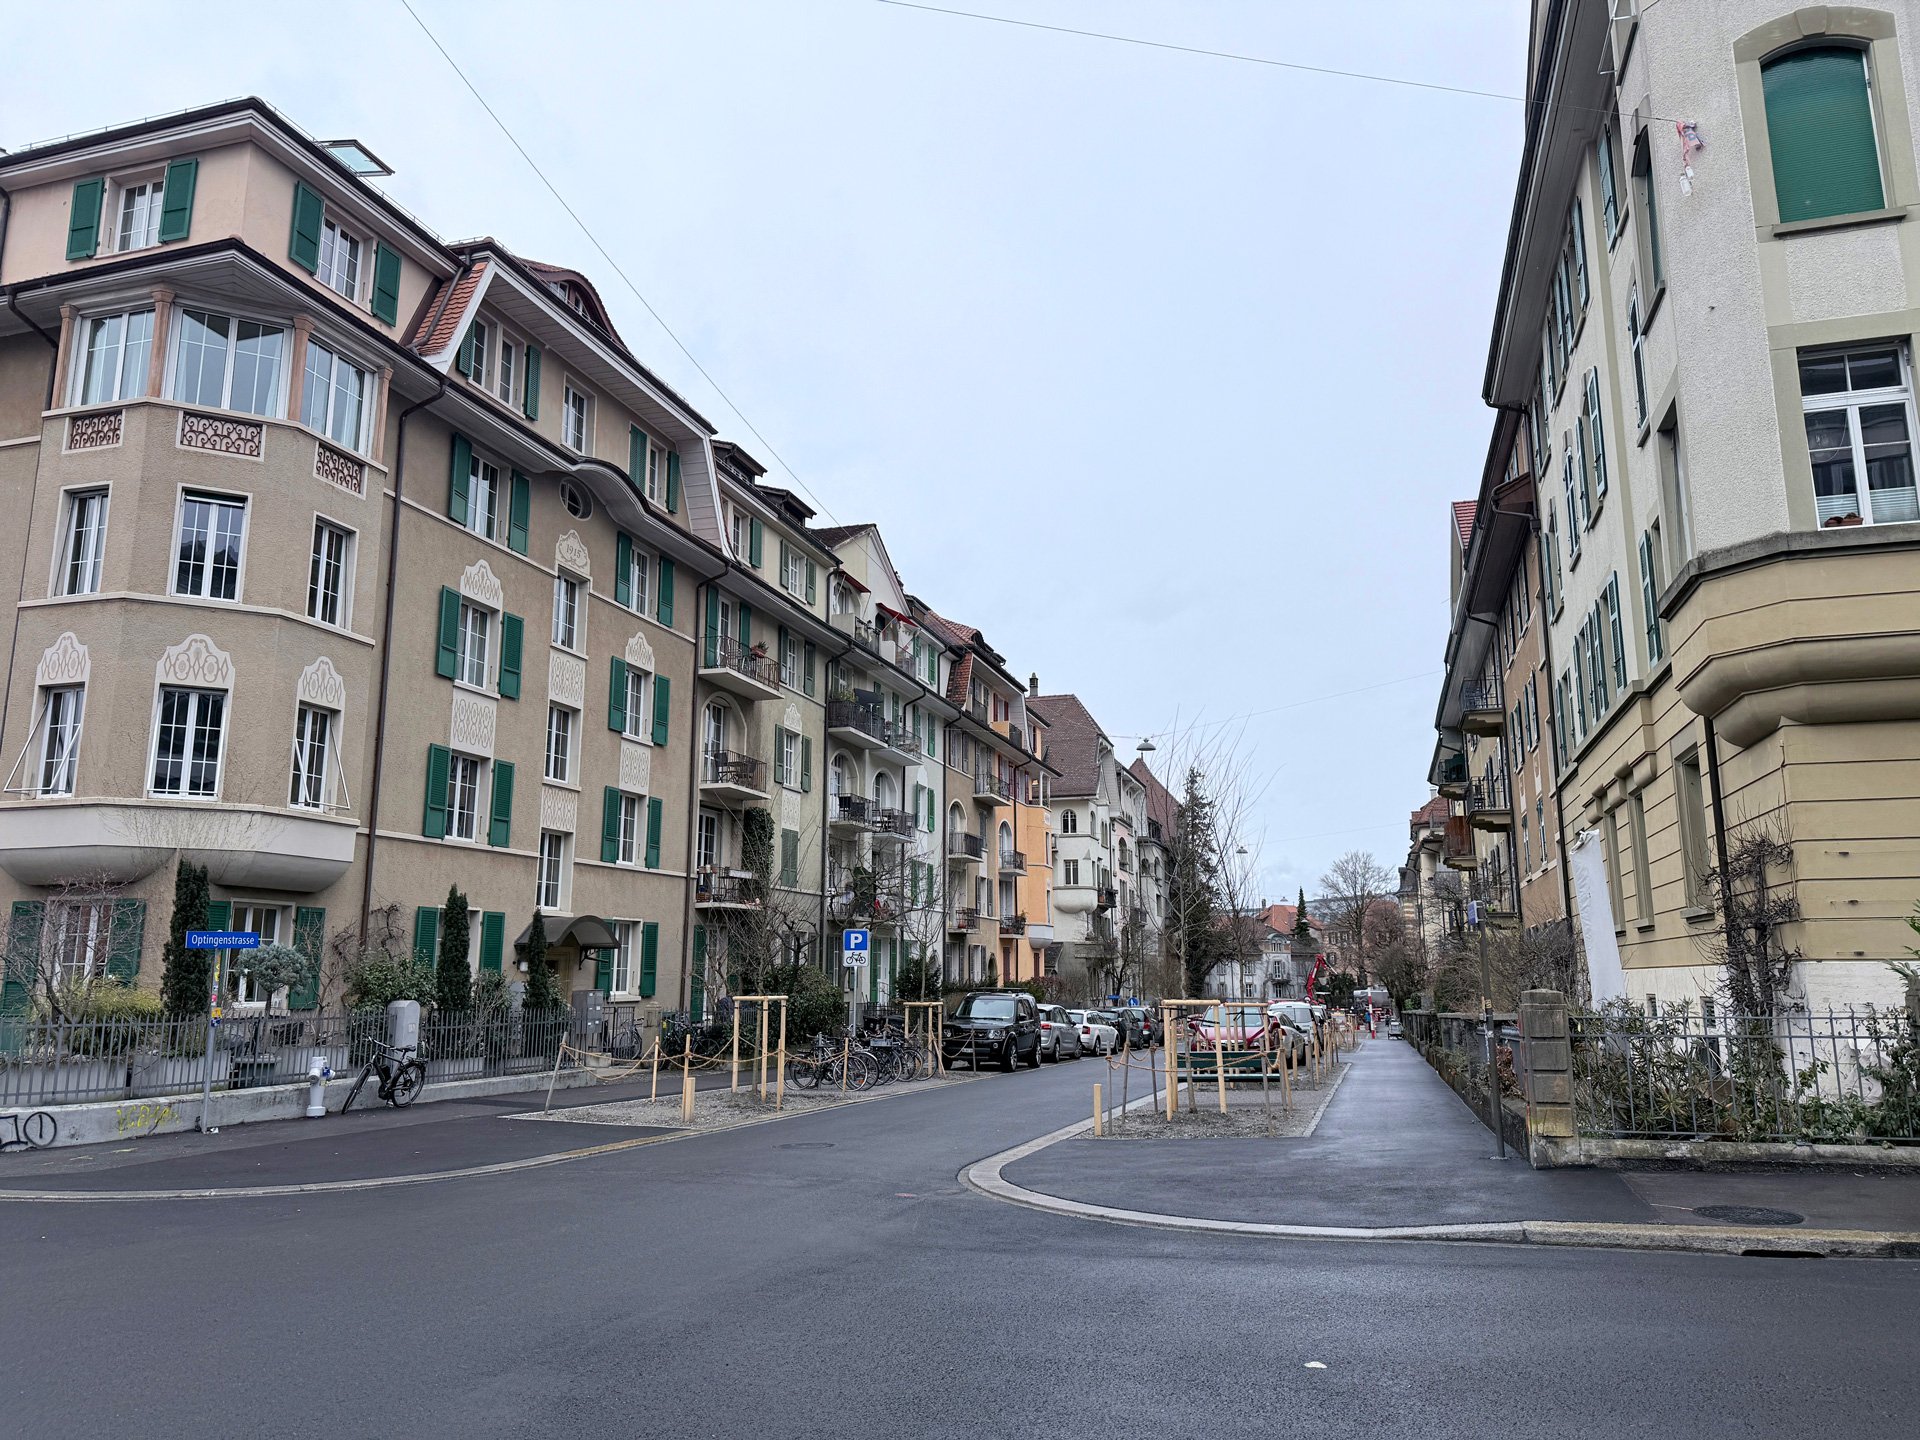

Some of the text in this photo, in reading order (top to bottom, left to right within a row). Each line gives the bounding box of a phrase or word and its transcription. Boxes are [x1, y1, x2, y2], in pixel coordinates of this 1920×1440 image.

[566, 544, 582, 559] 1915
[191, 934, 255, 947] Optingenstrasse
[850, 933, 863, 949] P
